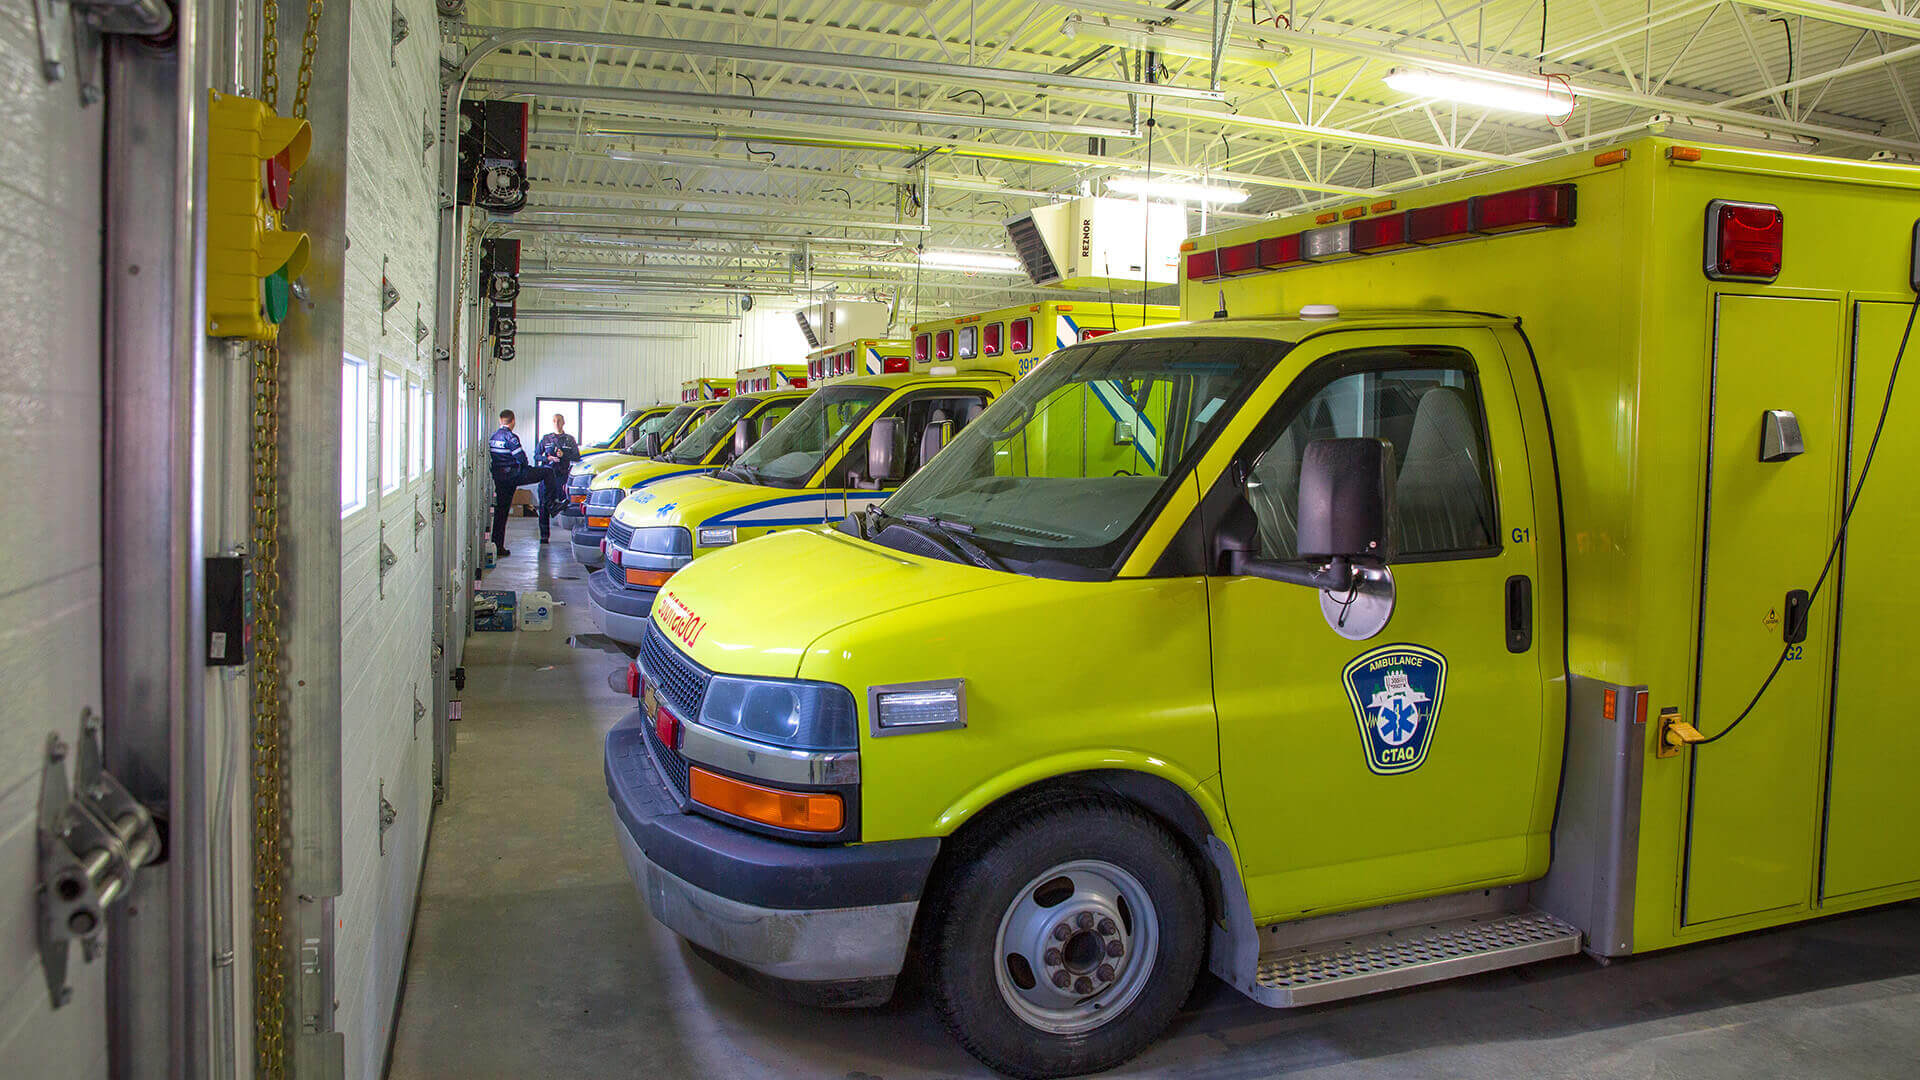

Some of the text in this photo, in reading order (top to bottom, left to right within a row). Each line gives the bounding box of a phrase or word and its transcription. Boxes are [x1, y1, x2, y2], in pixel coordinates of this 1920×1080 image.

[1082, 219, 1090, 257] REZNOR
[1512, 528, 1529, 543] G1
[1785, 646, 1802, 661] G2
[1369, 656, 1423, 672] AMBULANCE
[1382, 747, 1415, 763] CTAQ
